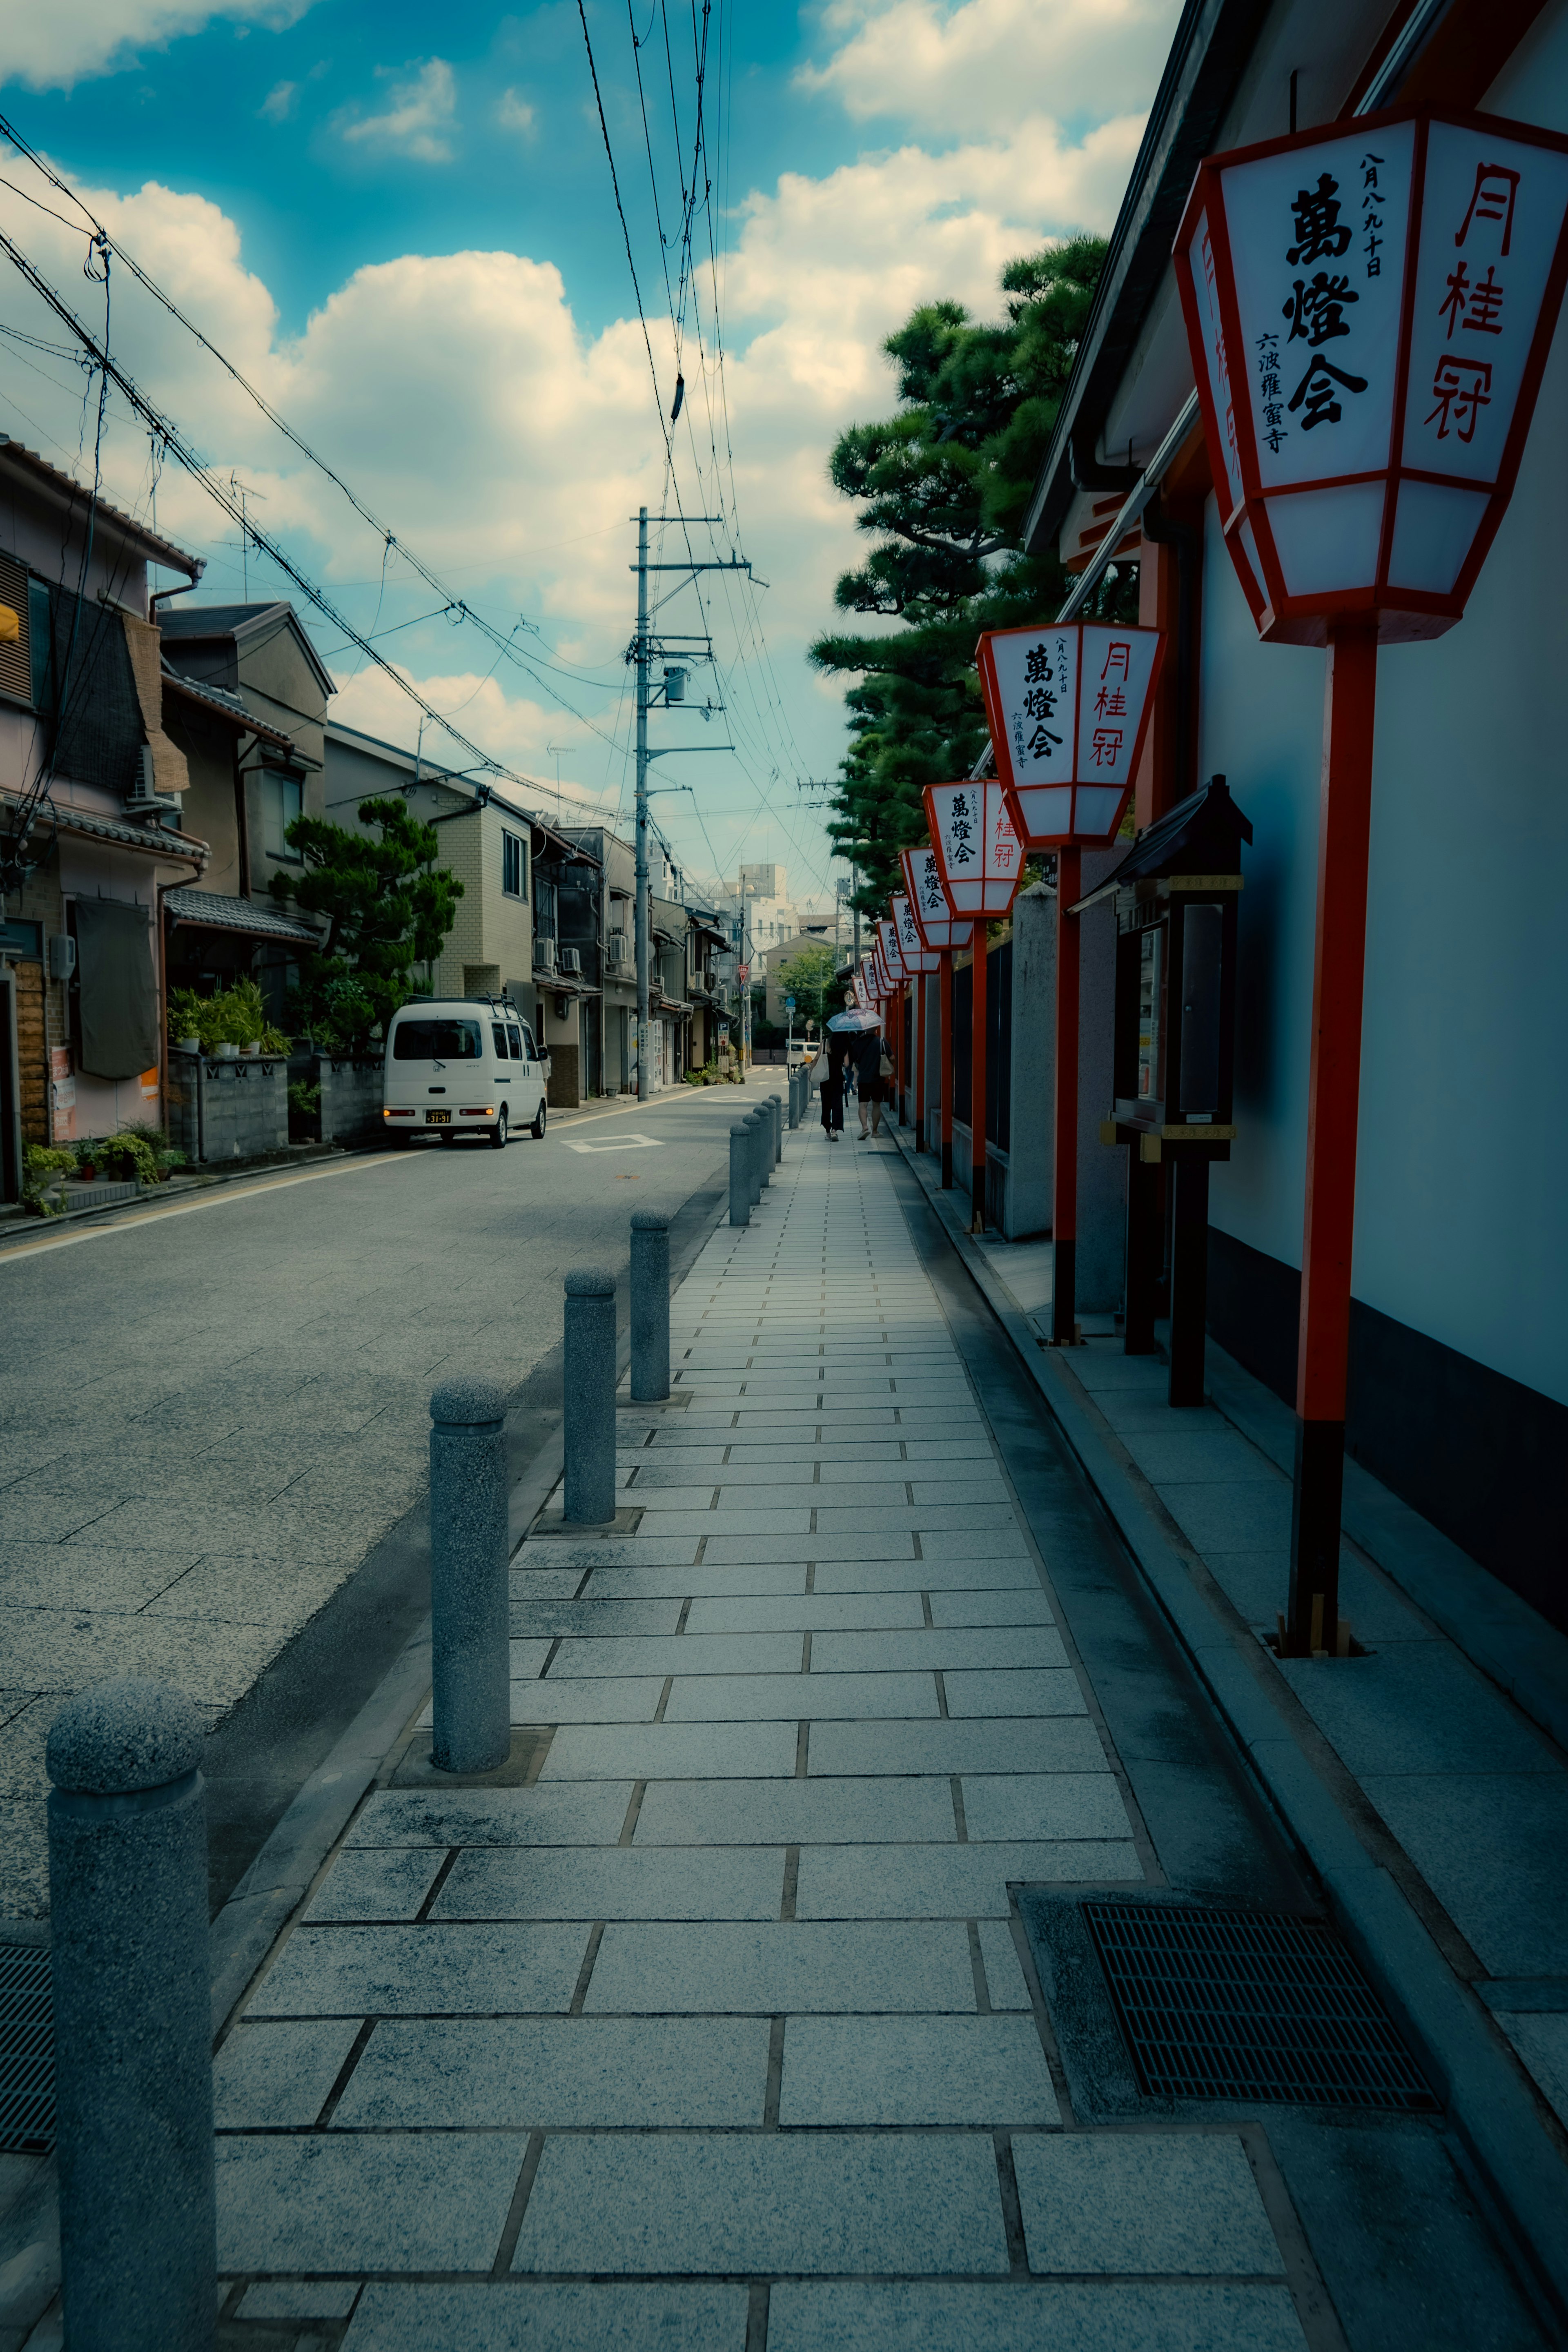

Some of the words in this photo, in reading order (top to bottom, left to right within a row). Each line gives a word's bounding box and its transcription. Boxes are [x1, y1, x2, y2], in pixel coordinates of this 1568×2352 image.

[1283, 172, 1368, 431] 萬燈会
[1424, 162, 1521, 443] 月桂冠
[1255, 334, 1288, 454] 六波羅蜜寺
[1011, 713, 1027, 768] 六波羅蜜寺
[1023, 644, 1062, 759] 萬燈会
[1089, 642, 1131, 766] 月桂冠
[951, 793, 976, 864] 萬燈会
[903, 903, 917, 942] 萬燈会
[924, 855, 944, 908] 萬燈会
[889, 927, 899, 958] 萬燈会
